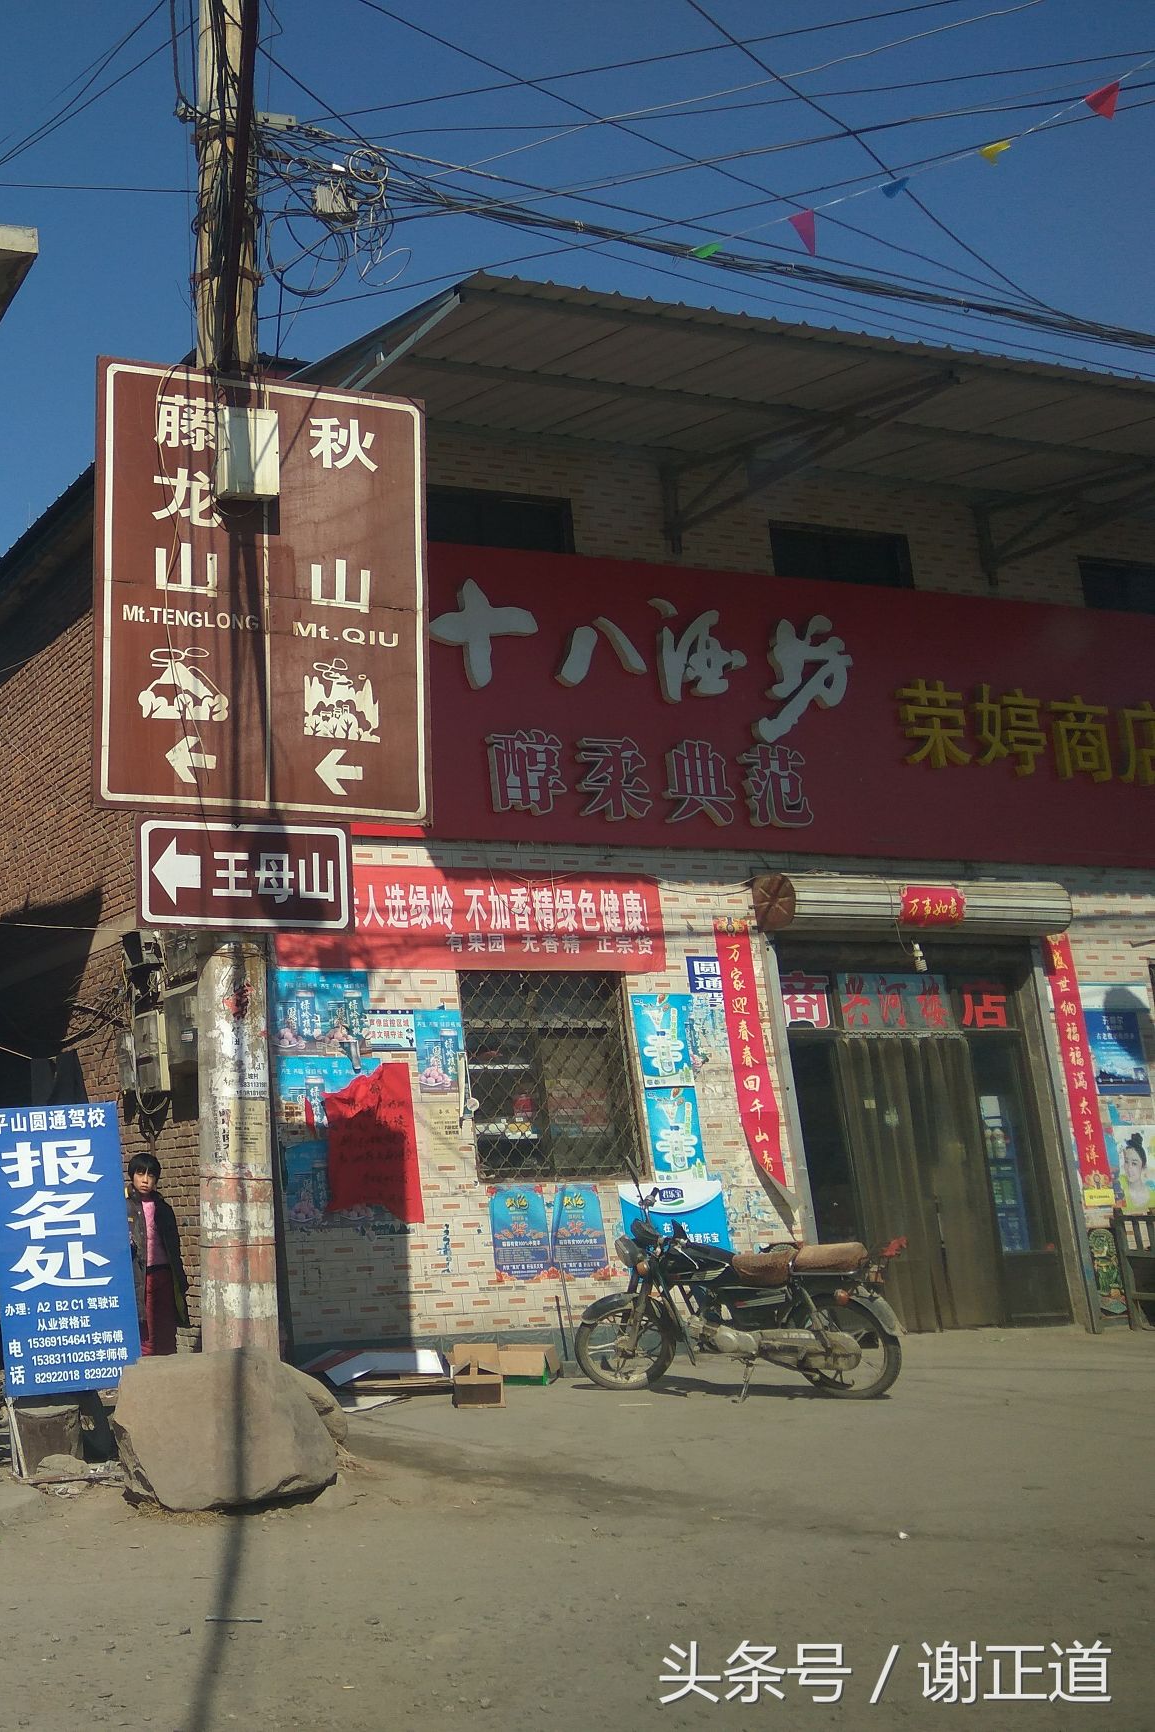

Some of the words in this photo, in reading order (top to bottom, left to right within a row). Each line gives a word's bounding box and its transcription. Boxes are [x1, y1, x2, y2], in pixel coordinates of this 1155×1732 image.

[152, 394, 223, 597] 藤龙山
[309, 417, 379, 614] 秋山
[485, 729, 815, 829] 醇柔典范
[212, 851, 336, 904] 王母山
[909, 896, 959, 919] 万事如意
[446, 932, 506, 954] 有果园
[521, 933, 581, 955] 无香精
[596, 935, 654, 955] 正宗货
[961, 979, 1008, 1029] 店
[0, 1139, 113, 1292] 报名处
[663, 1222, 689, 1234] 在北
[37, 1302, 50, 1313] A2
[56, 1300, 69, 1311] B2
[71, 1299, 84, 1310] C1
[87, 1296, 119, 1309] 驾驶证
[37, 1316, 91, 1332] 从业资格证
[28, 1330, 124, 1349] 15369154641安师傅
[8, 1339, 26, 1385] 电话
[32, 1347, 128, 1366] 15383110263李师傅
[35, 1370, 80, 1384] 82922018
[85, 1367, 123, 1380] 8292201
